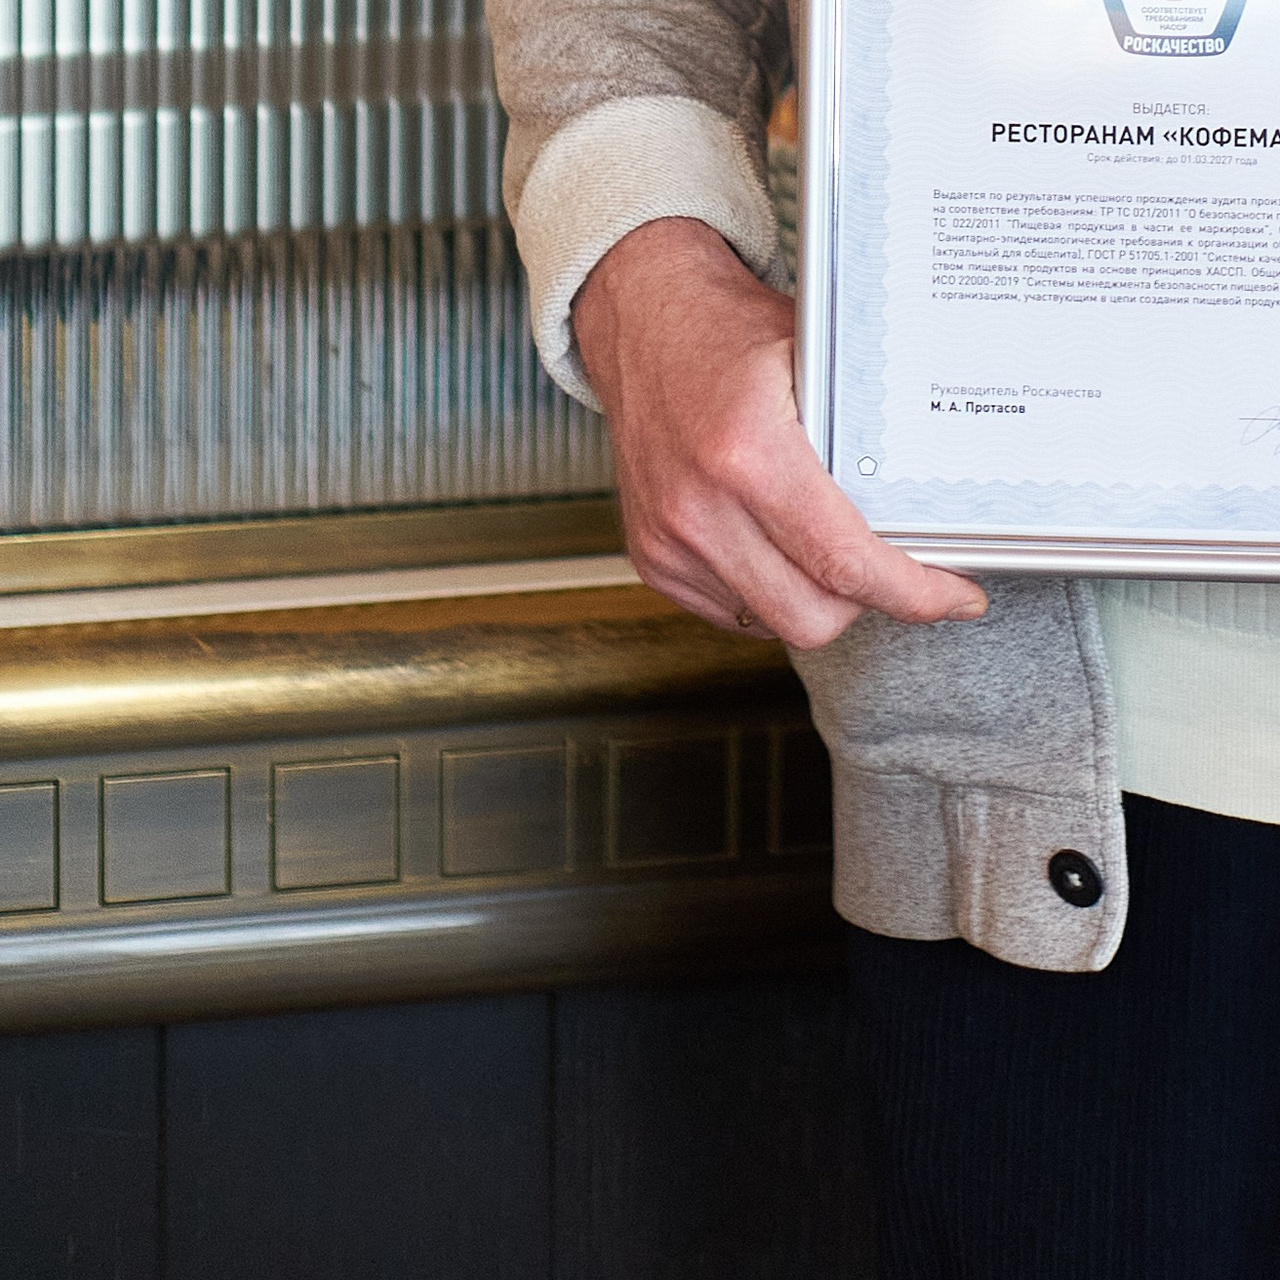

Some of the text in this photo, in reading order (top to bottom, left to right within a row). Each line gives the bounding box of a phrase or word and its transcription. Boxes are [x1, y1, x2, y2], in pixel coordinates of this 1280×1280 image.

[1123, 35, 1226, 54] РОСКАЧЕСТВО
[1131, 102, 1210, 116] ВЫДАЕТСЯ:
[990, 123, 1155, 144] РЕСТОРАНАМ
[1086, 152, 1111, 163] Срок
[1113, 153, 1163, 163] действия:
[1235, 157, 1258, 166] года
[932, 189, 986, 200] Выдается
[1005, 193, 1072, 202] результатам
[1074, 194, 1133, 203] успешного
[1135, 196, 1208, 205] прохождения
[1210, 197, 1248, 206] аудита
[948, 206, 1020, 215] соответствие
[1022, 206, 1097, 216] требованиям:
[1132, 207, 1180, 218] 021/2011
[1198, 209, 1273, 220] безопасности
[951, 217, 1000, 229] 022/2011
[1066, 223, 1125, 232] продукция
[1142, 224, 1174, 232] части
[1119, 236, 1184, 247] требования
[1196, 240, 1269, 249] организации
[1001, 250, 1022, 259] для
[1087, 248, 1116, 260] ГОСТ
[931, 262, 964, 271] ством
[967, 263, 1018, 272] пищевых
[1022, 264, 1078, 274] продуктов
[1098, 266, 1138, 275] основе
[1141, 267, 1202, 276] принципов
[1206, 266, 1246, 277] ХАССП.
[932, 274, 956, 285] ИСО
[958, 275, 1020, 286] 22000-2019
[1076, 280, 1151, 289] менеджмента
[1153, 279, 1228, 291] безопасности
[1230, 282, 1280, 292] пищевой
[940, 291, 1021, 301] организациям,
[1023, 293, 1098, 303] участвующим
[1109, 295, 1137, 303] цепи
[1139, 296, 1190, 305] создания
[1192, 296, 1242, 305] пищевой
[930, 383, 1102, 398] Руководитель Роскачества
[930, 401, 1026, 414] М. А. Протасов
